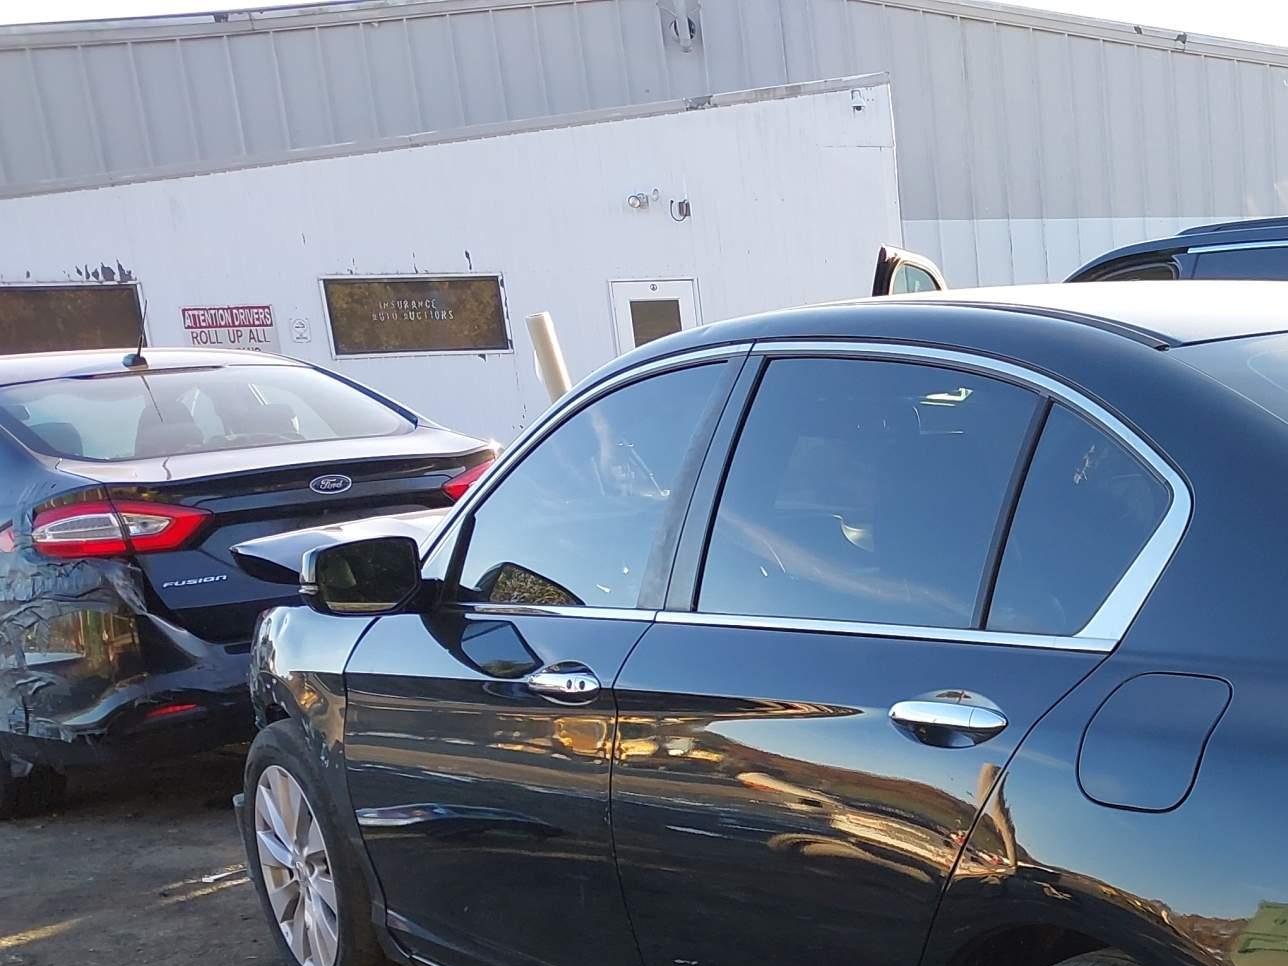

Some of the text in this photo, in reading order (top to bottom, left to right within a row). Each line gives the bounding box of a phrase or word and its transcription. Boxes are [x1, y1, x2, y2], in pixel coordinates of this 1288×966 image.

[184, 308, 272, 328] ATTENTION DRIVERS
[191, 328, 271, 345] ROLL UP ALL
[320, 479, 343, 489] Ford
[163, 575, 227, 588] FUSION
